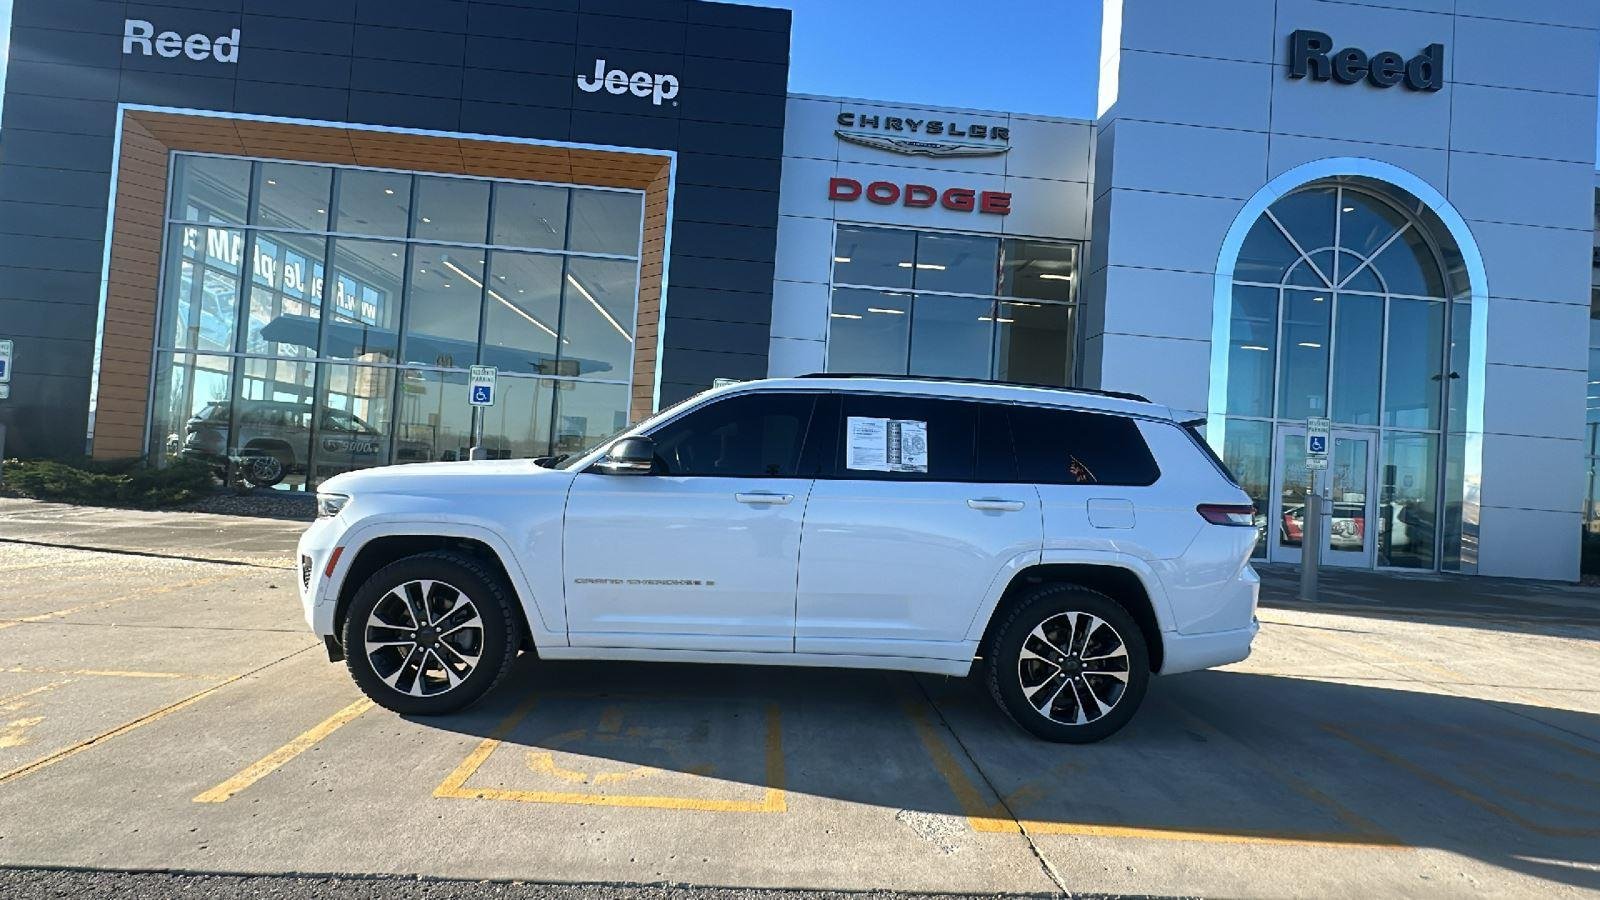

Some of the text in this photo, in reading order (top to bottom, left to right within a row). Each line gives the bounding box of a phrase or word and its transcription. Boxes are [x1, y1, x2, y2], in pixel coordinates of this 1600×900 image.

[122, 18, 240, 63] Reed
[1288, 29, 1445, 92] Reed
[577, 59, 679, 105] Jeep
[837, 112, 1010, 141] CHRYSLER
[828, 177, 1012, 215] DODGE
